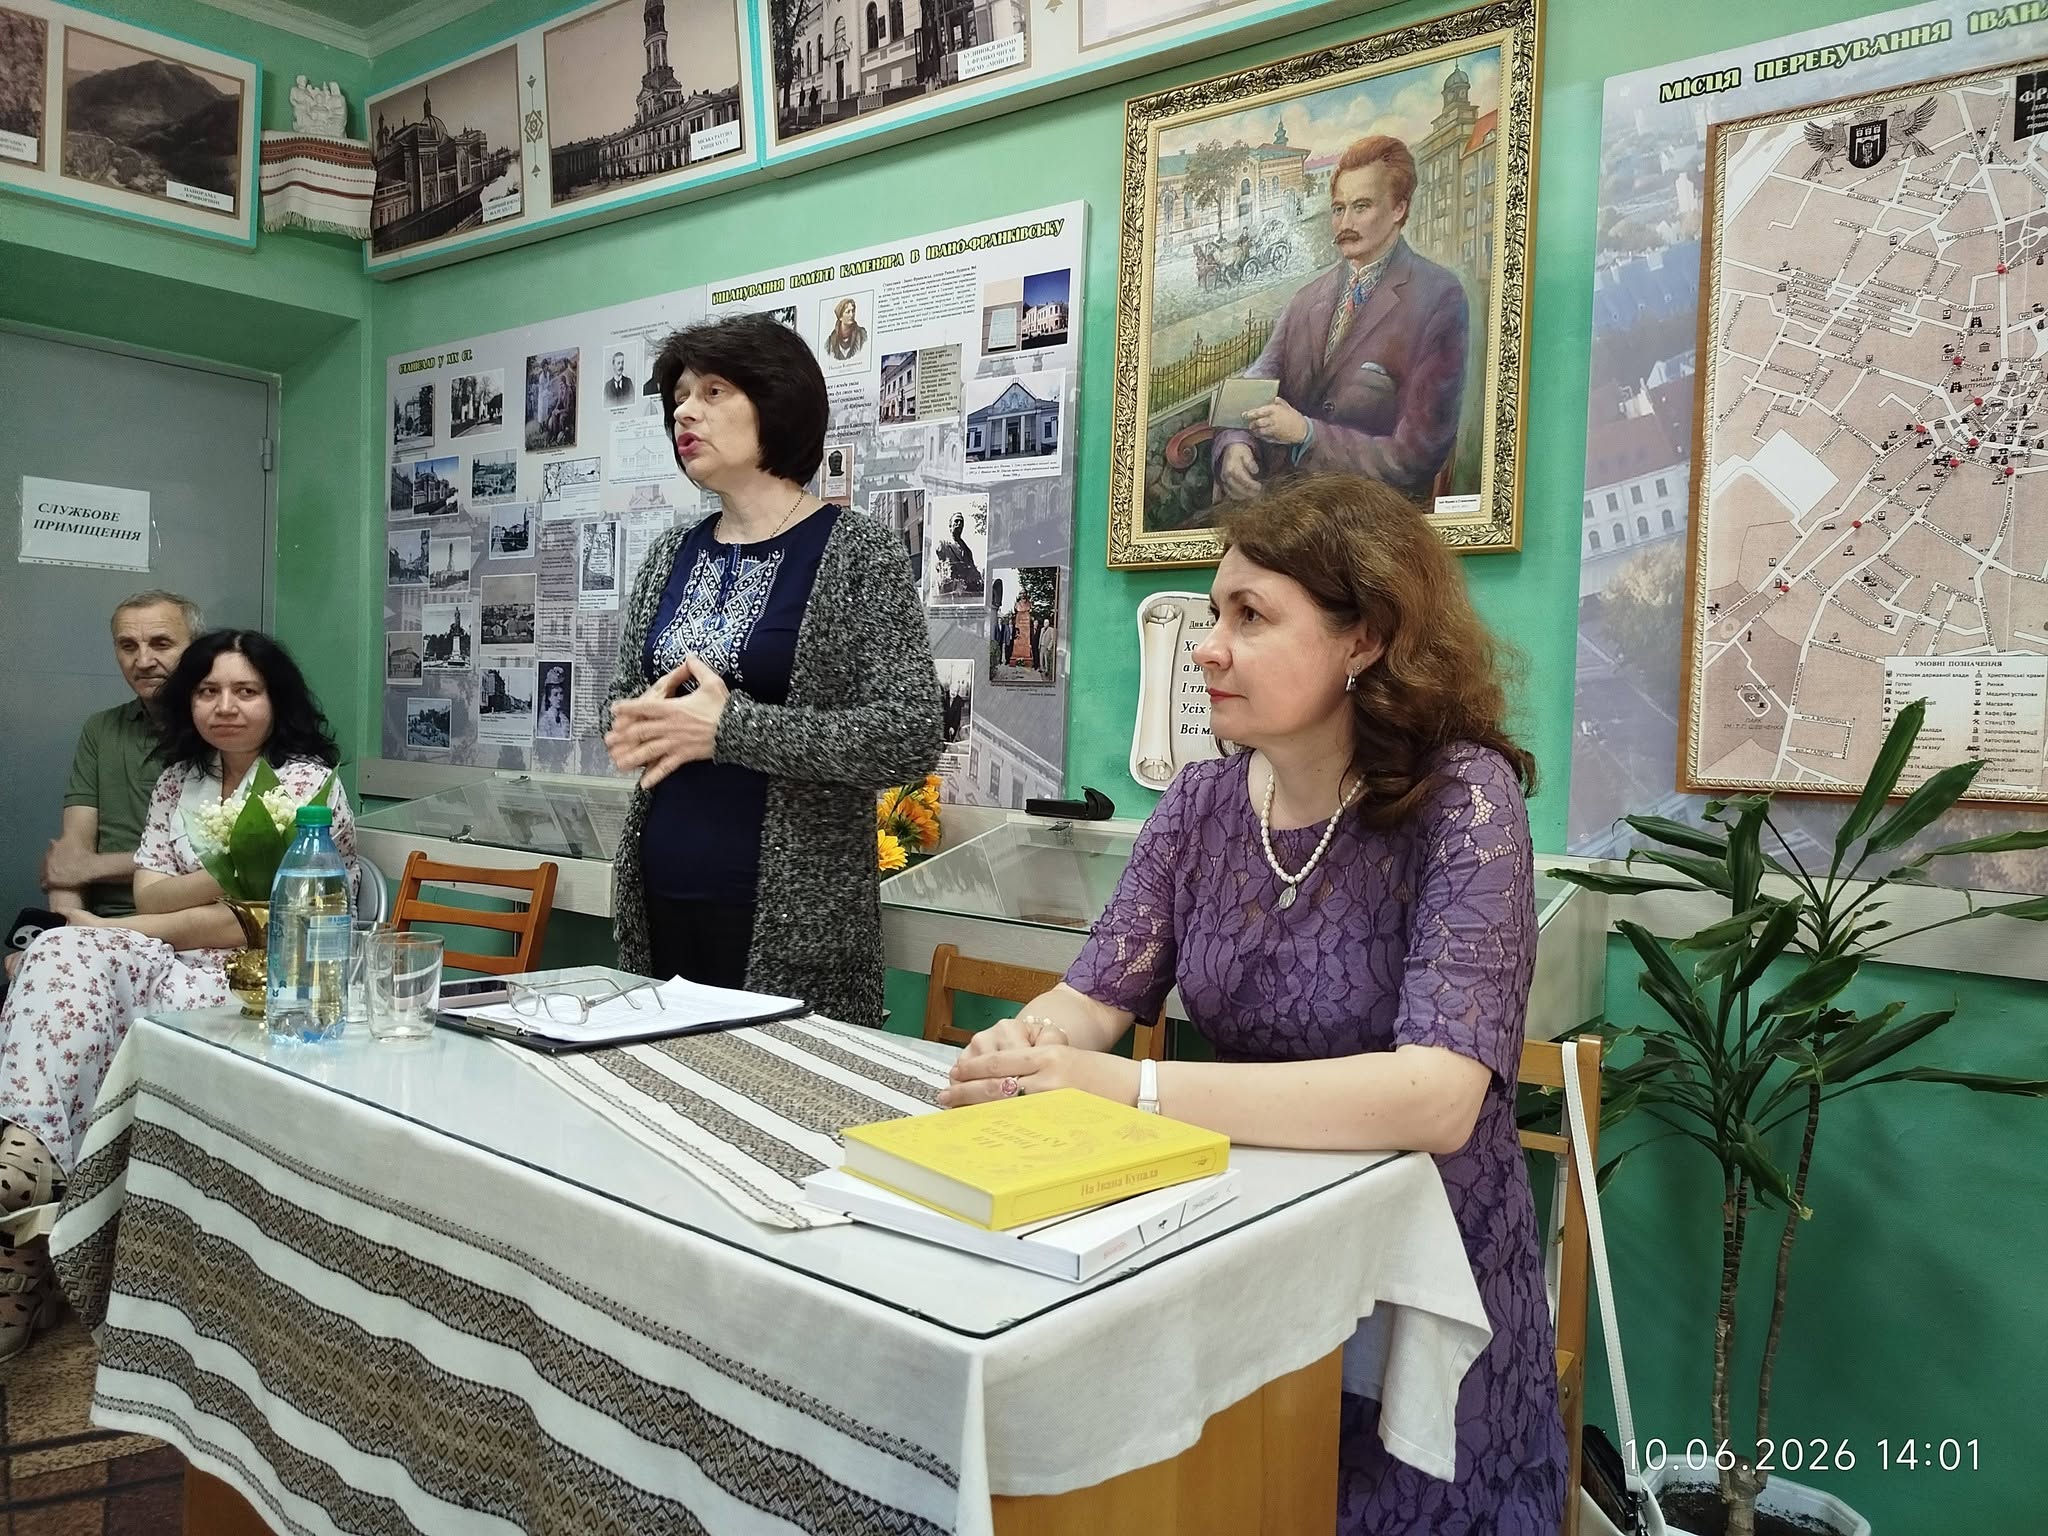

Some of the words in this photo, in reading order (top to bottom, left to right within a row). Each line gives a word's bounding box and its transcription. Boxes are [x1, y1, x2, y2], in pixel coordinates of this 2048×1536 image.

[1660, 67, 1741, 103] МІСЦЯ
[1755, 19, 1952, 83] ПЕРЕБУВАННЯ
[712, 278, 785, 305] ВШАНУВАННЯ
[840, 253, 904, 279] КАМЕНЯРА
[910, 249, 920, 263] В
[926, 218, 1065, 260] ІВАНО-ФРАНКІВСЬКУ
[38, 502, 121, 523] СЛУЖБОВЕ
[33, 519, 141, 541] ПРИМІЩЕННЯ
[1183, 664, 1190, 672] а
[1182, 683, 1187, 692] І
[1181, 703, 1206, 713] Усіх
[1180, 724, 1198, 734] Всі
